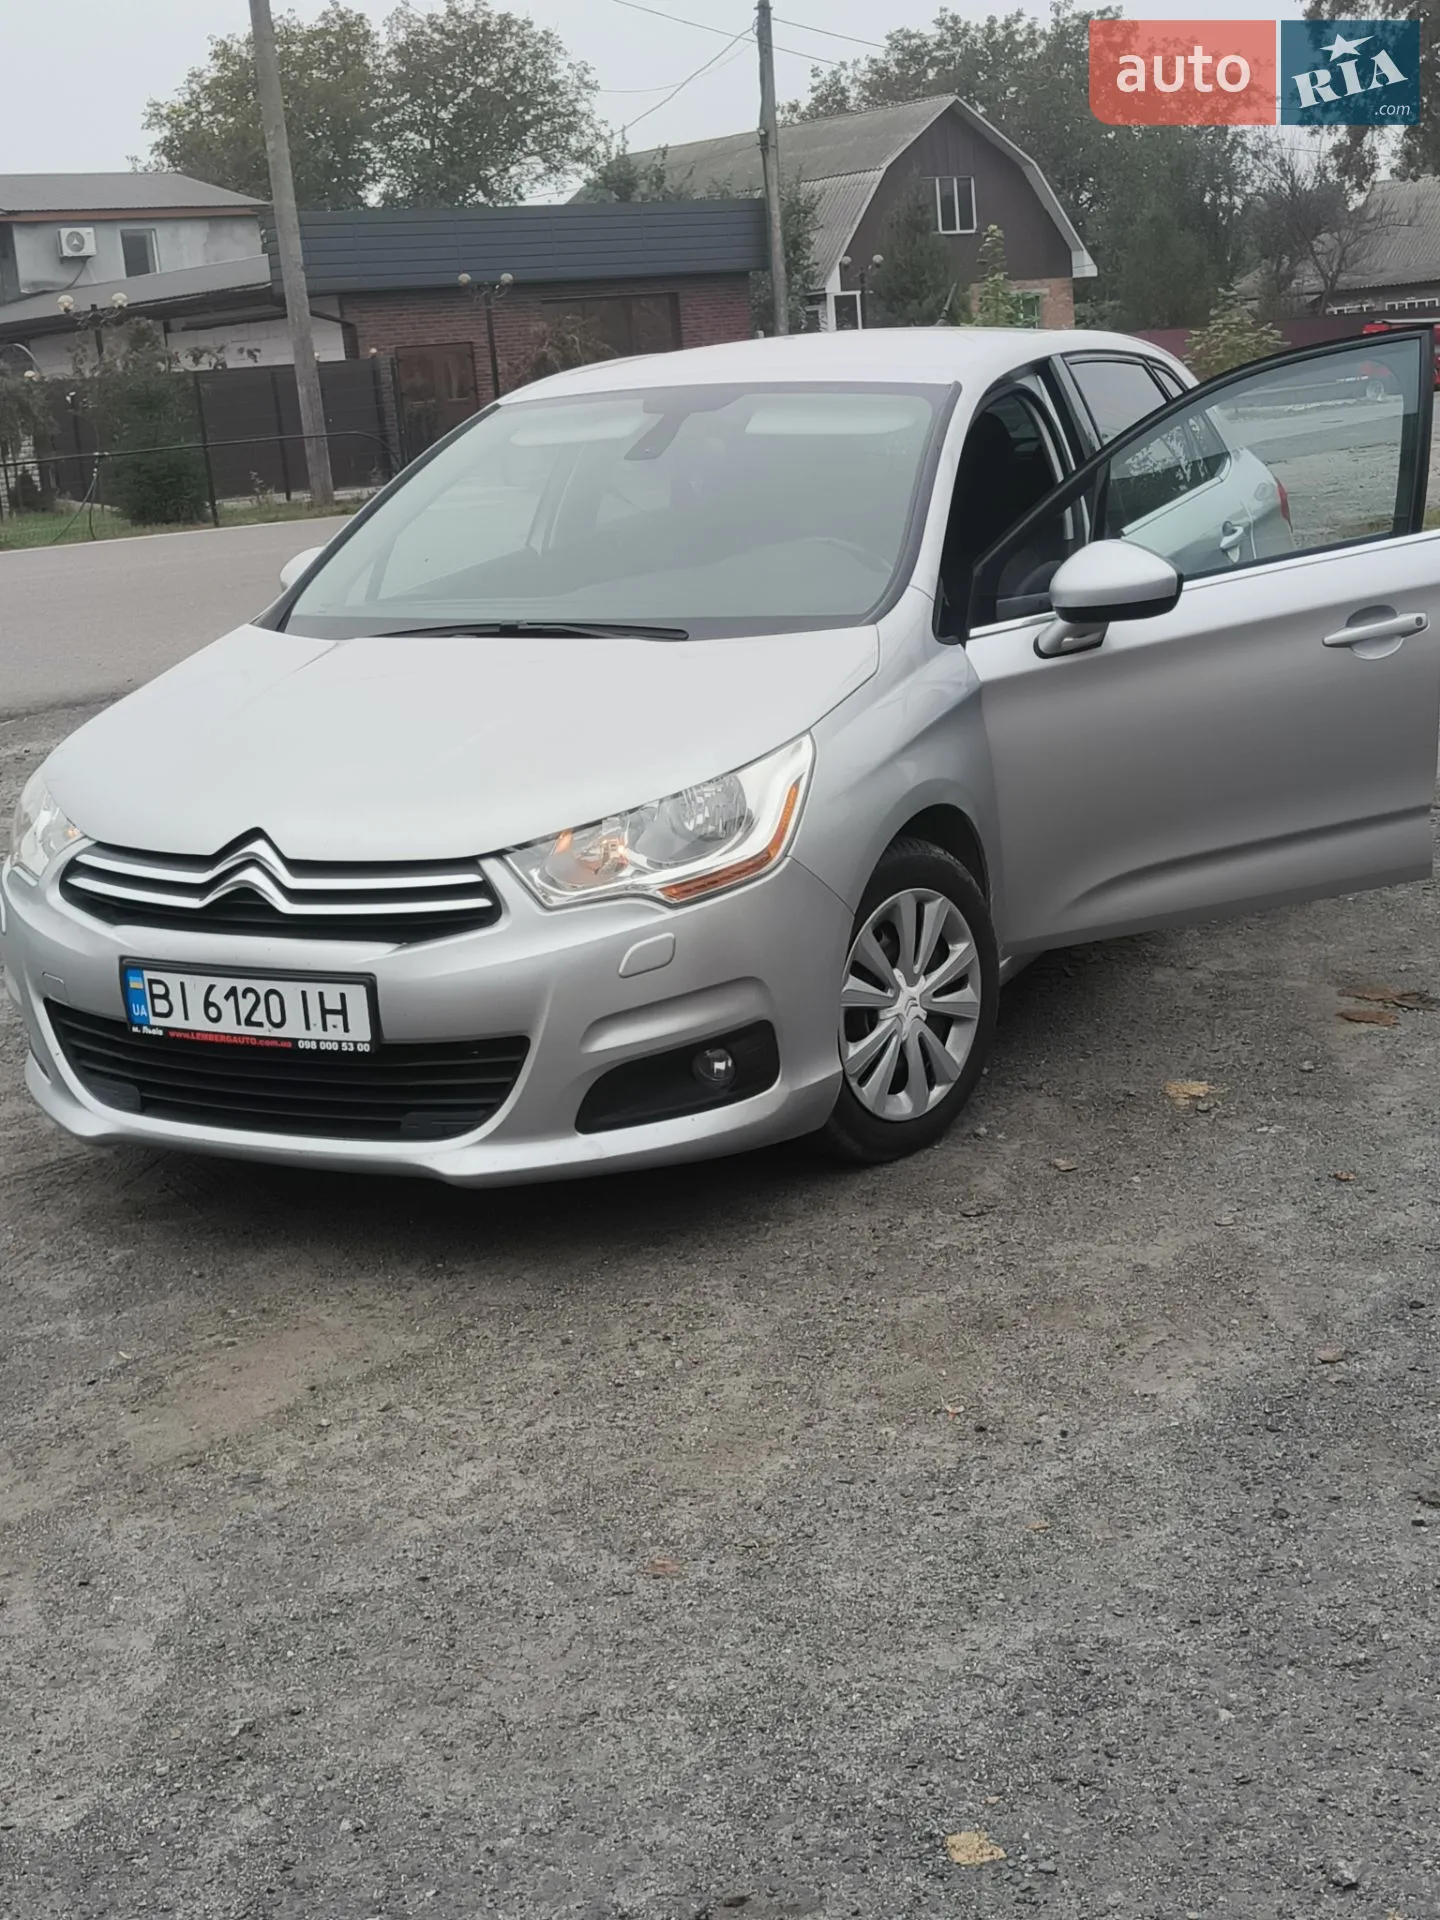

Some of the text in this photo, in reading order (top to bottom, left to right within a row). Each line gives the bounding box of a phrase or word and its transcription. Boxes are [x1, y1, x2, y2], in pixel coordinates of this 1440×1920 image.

[132, 1003, 148, 1017] UA
[147, 978, 349, 1033] BI 6120 IH
[298, 1040, 317, 1050] 098
[341, 1042, 355, 1051] 53
[357, 1043, 371, 1052] 00
